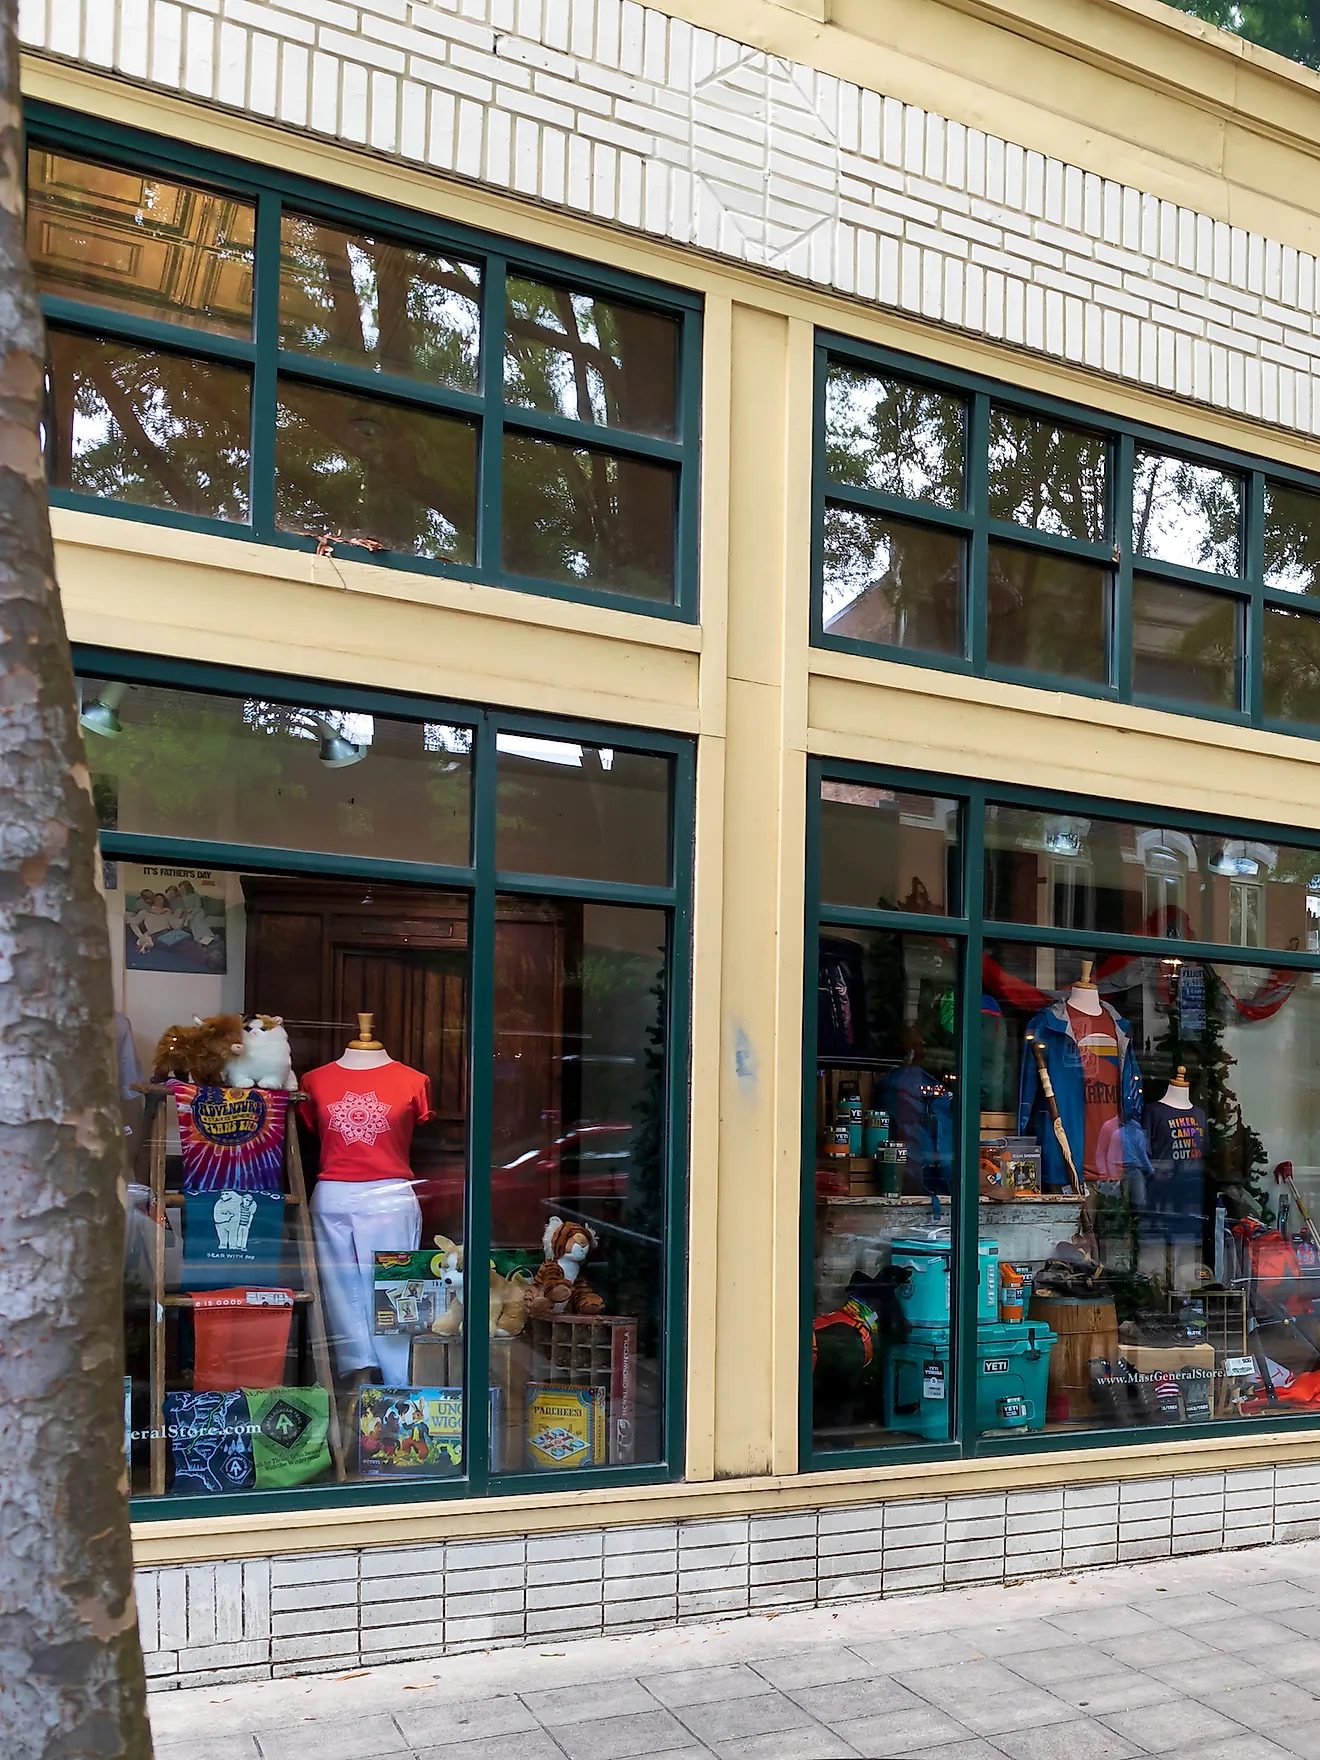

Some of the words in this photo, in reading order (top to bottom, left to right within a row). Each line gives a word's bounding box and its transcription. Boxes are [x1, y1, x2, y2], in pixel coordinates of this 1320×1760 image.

[144, 866, 158, 876] IT'S
[160, 868, 195, 878] FATHER'S
[197, 871, 212, 880] DAY
[199, 1100, 263, 1117] ADVENTURE
[203, 1120, 236, 1134] PLANS
[239, 1120, 258, 1132] END
[1168, 1117, 1198, 1128] HIKER
[985, 1362, 1007, 1371] YETI
[1096, 1368, 1226, 1385] www.MastGeneralStore.
[438, 1403, 462, 1415] UNC
[534, 1406, 582, 1417] PARCHEESI
[131, 1424, 262, 1440] eralStore.com
